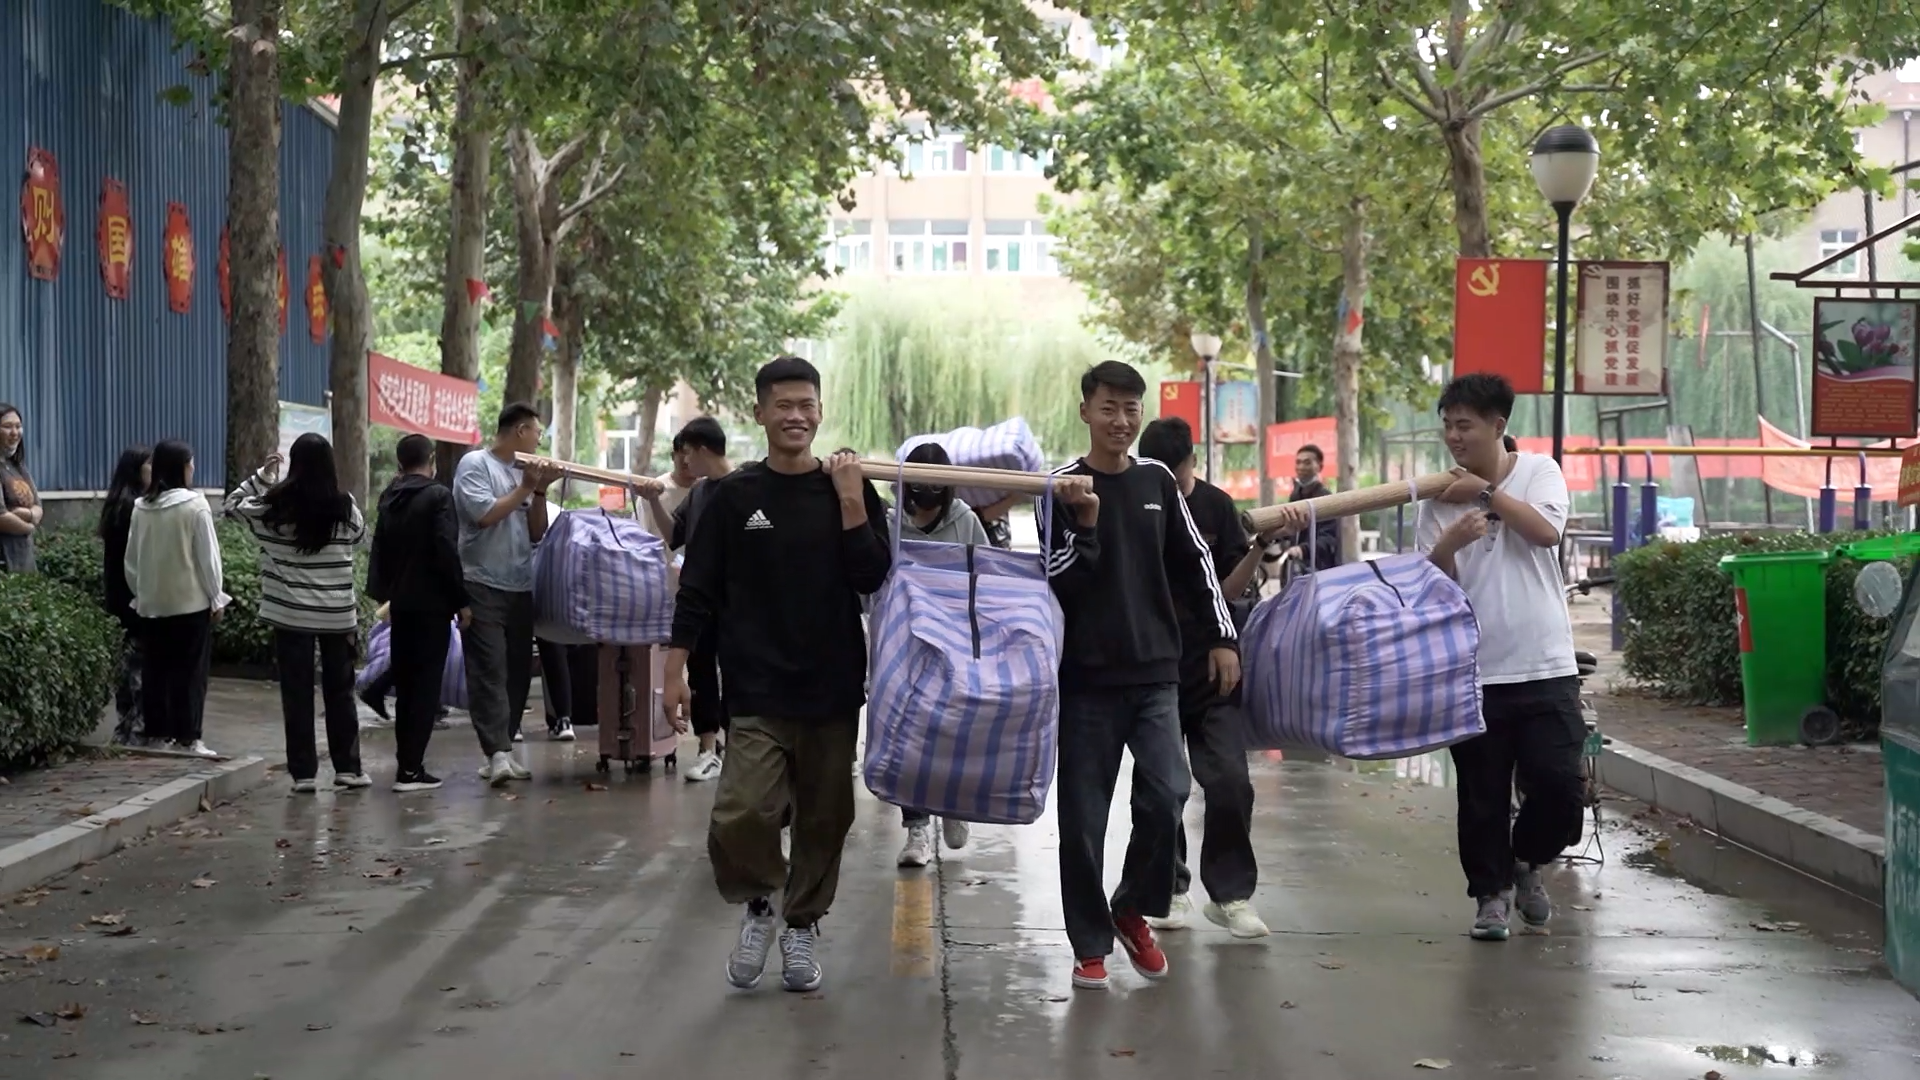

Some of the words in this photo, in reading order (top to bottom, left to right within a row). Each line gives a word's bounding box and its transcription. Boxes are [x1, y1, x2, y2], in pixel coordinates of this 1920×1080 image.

[1604, 276, 1619, 386] 围绕中心抓党建
[1625, 276, 1641, 386] 抓好党建促发展
